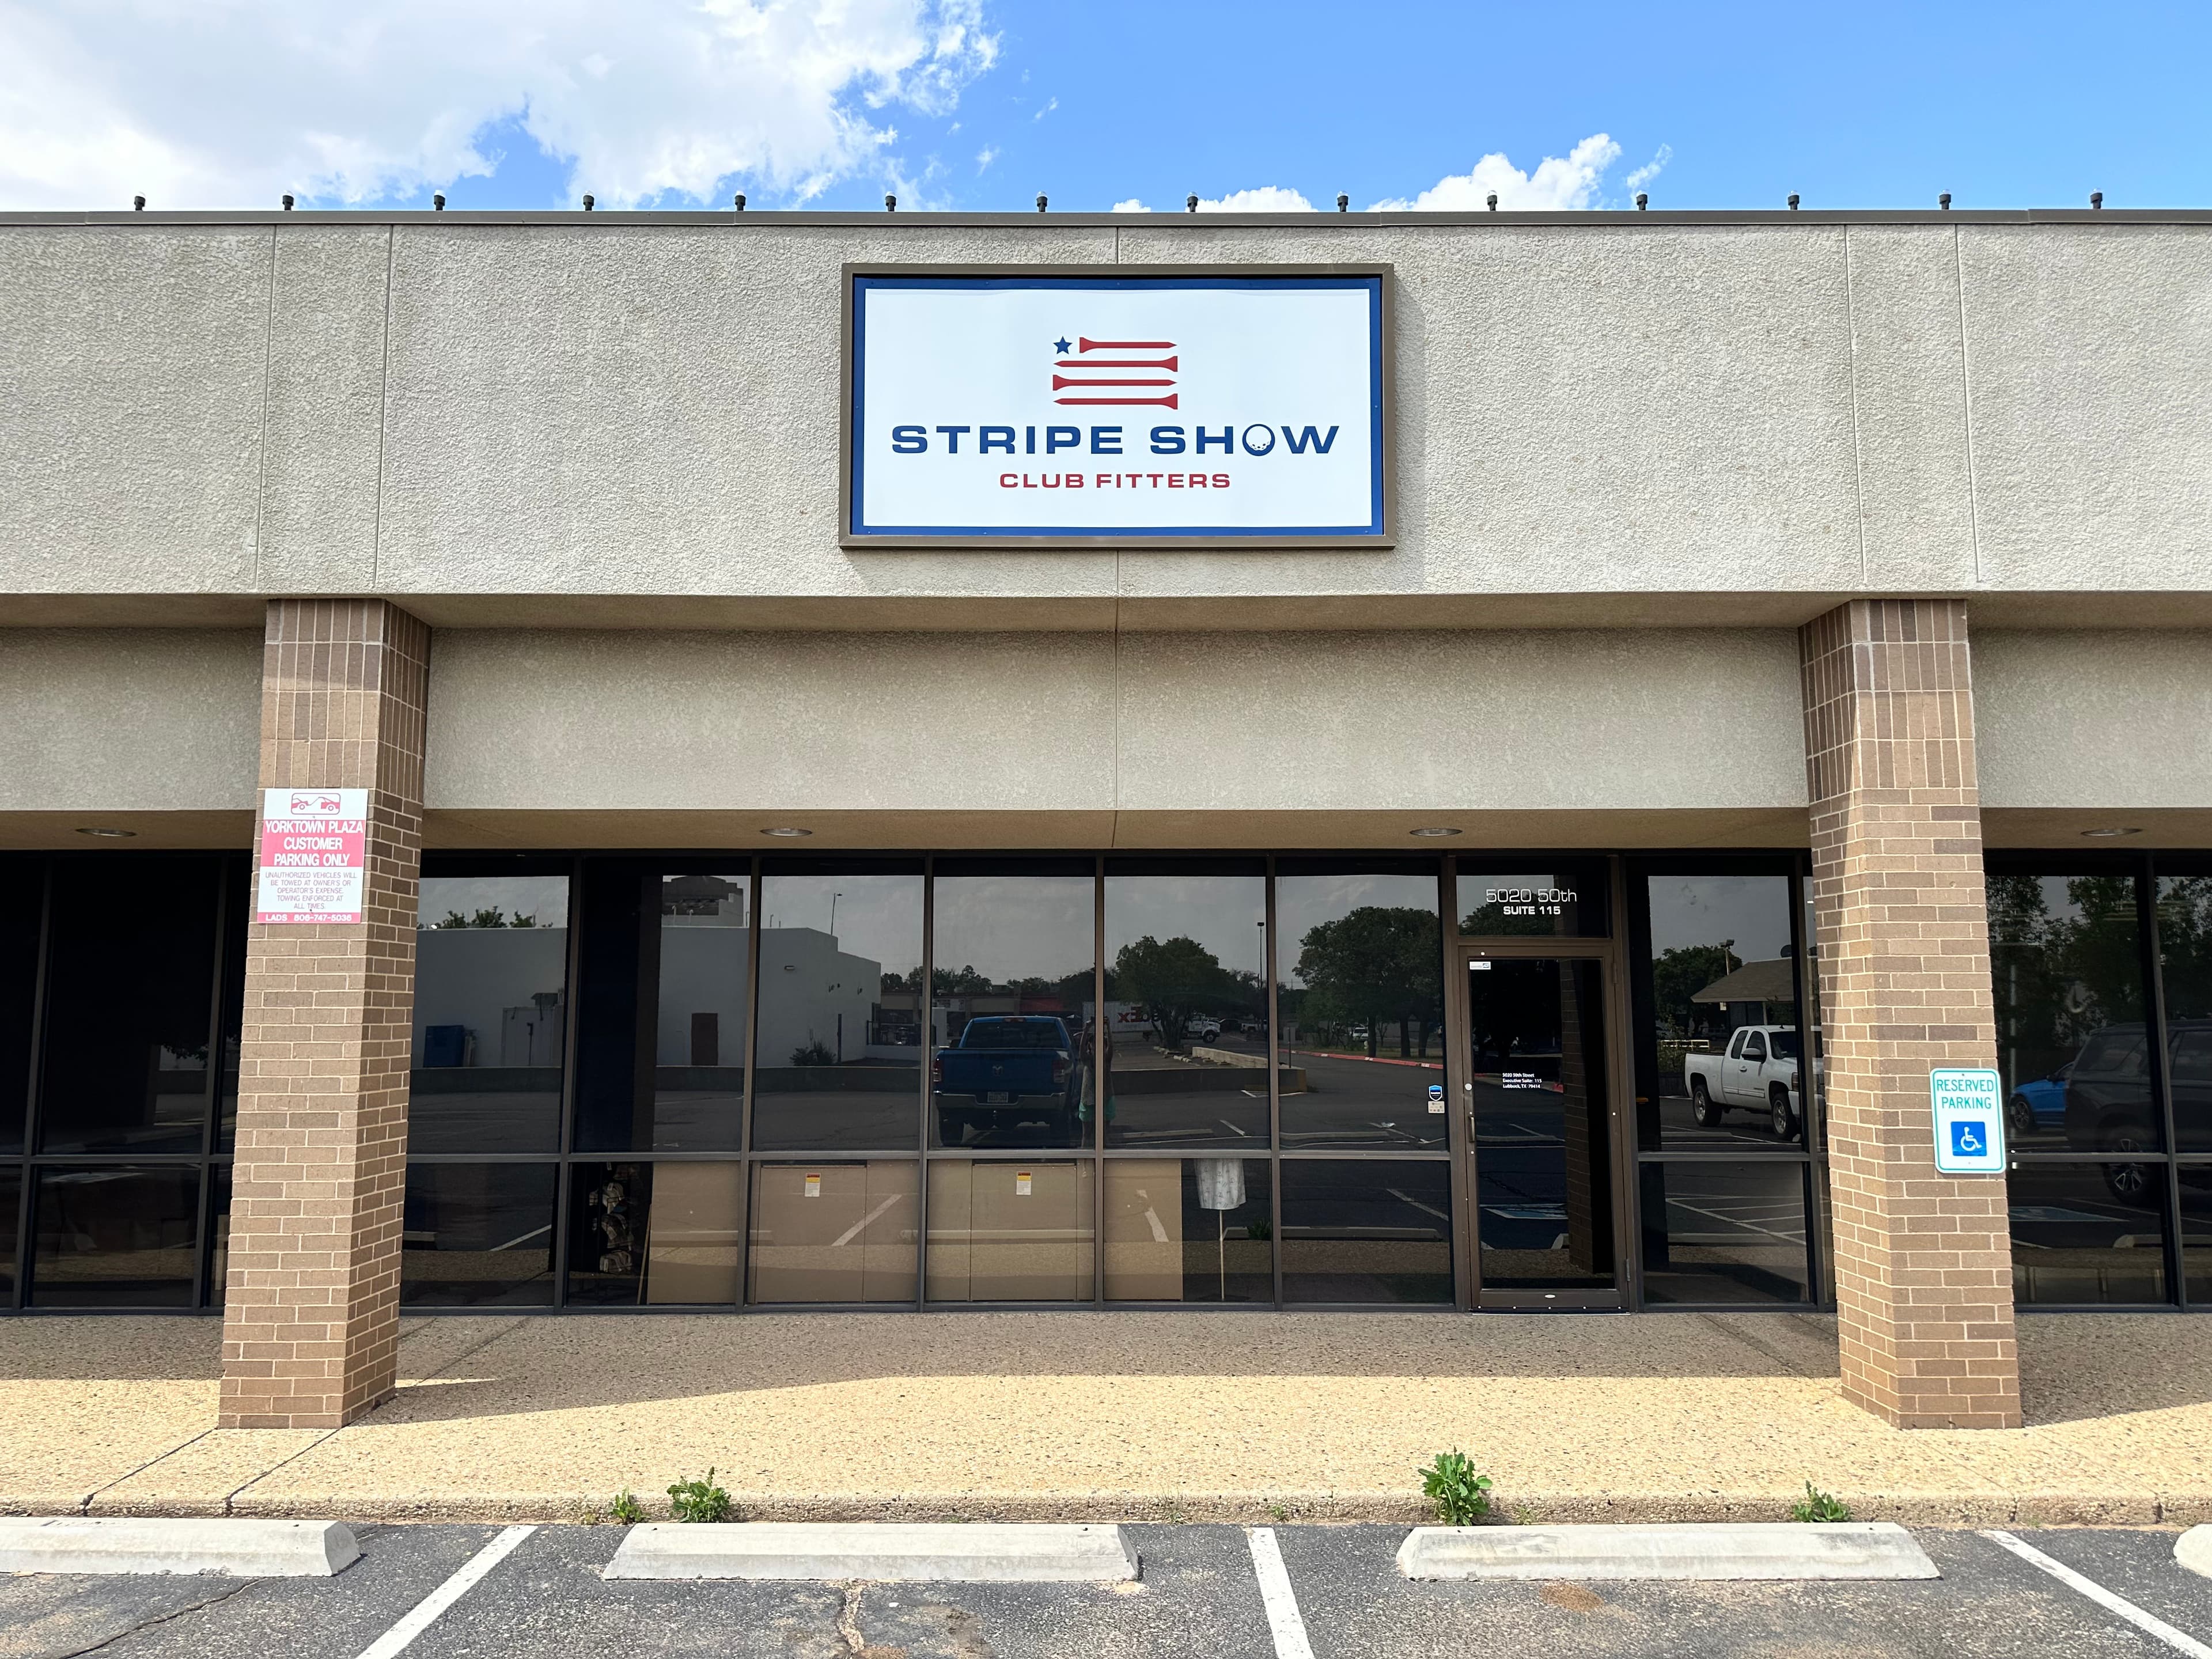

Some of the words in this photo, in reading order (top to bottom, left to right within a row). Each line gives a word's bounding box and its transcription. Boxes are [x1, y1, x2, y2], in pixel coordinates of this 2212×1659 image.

[892, 425, 1123, 454] STRIPE
[1149, 423, 1339, 457] SHOW
[999, 474, 1084, 489] CLUB
[1096, 474, 1231, 488] FITTERS
[265, 820, 325, 834] YORKTOWN
[328, 821, 363, 834] PLAZA
[283, 837, 343, 850] CUSTOMER
[274, 853, 320, 866] PARKING
[323, 853, 350, 866] ONLY
[1486, 889, 1532, 903] 5020
[1537, 889, 1577, 903] 50th
[1503, 906, 1535, 915] SUITE
[1539, 906, 1561, 915] 115
[1937, 1079, 1994, 1092] RESERVED
[1941, 1097, 1992, 1109] PARKING
